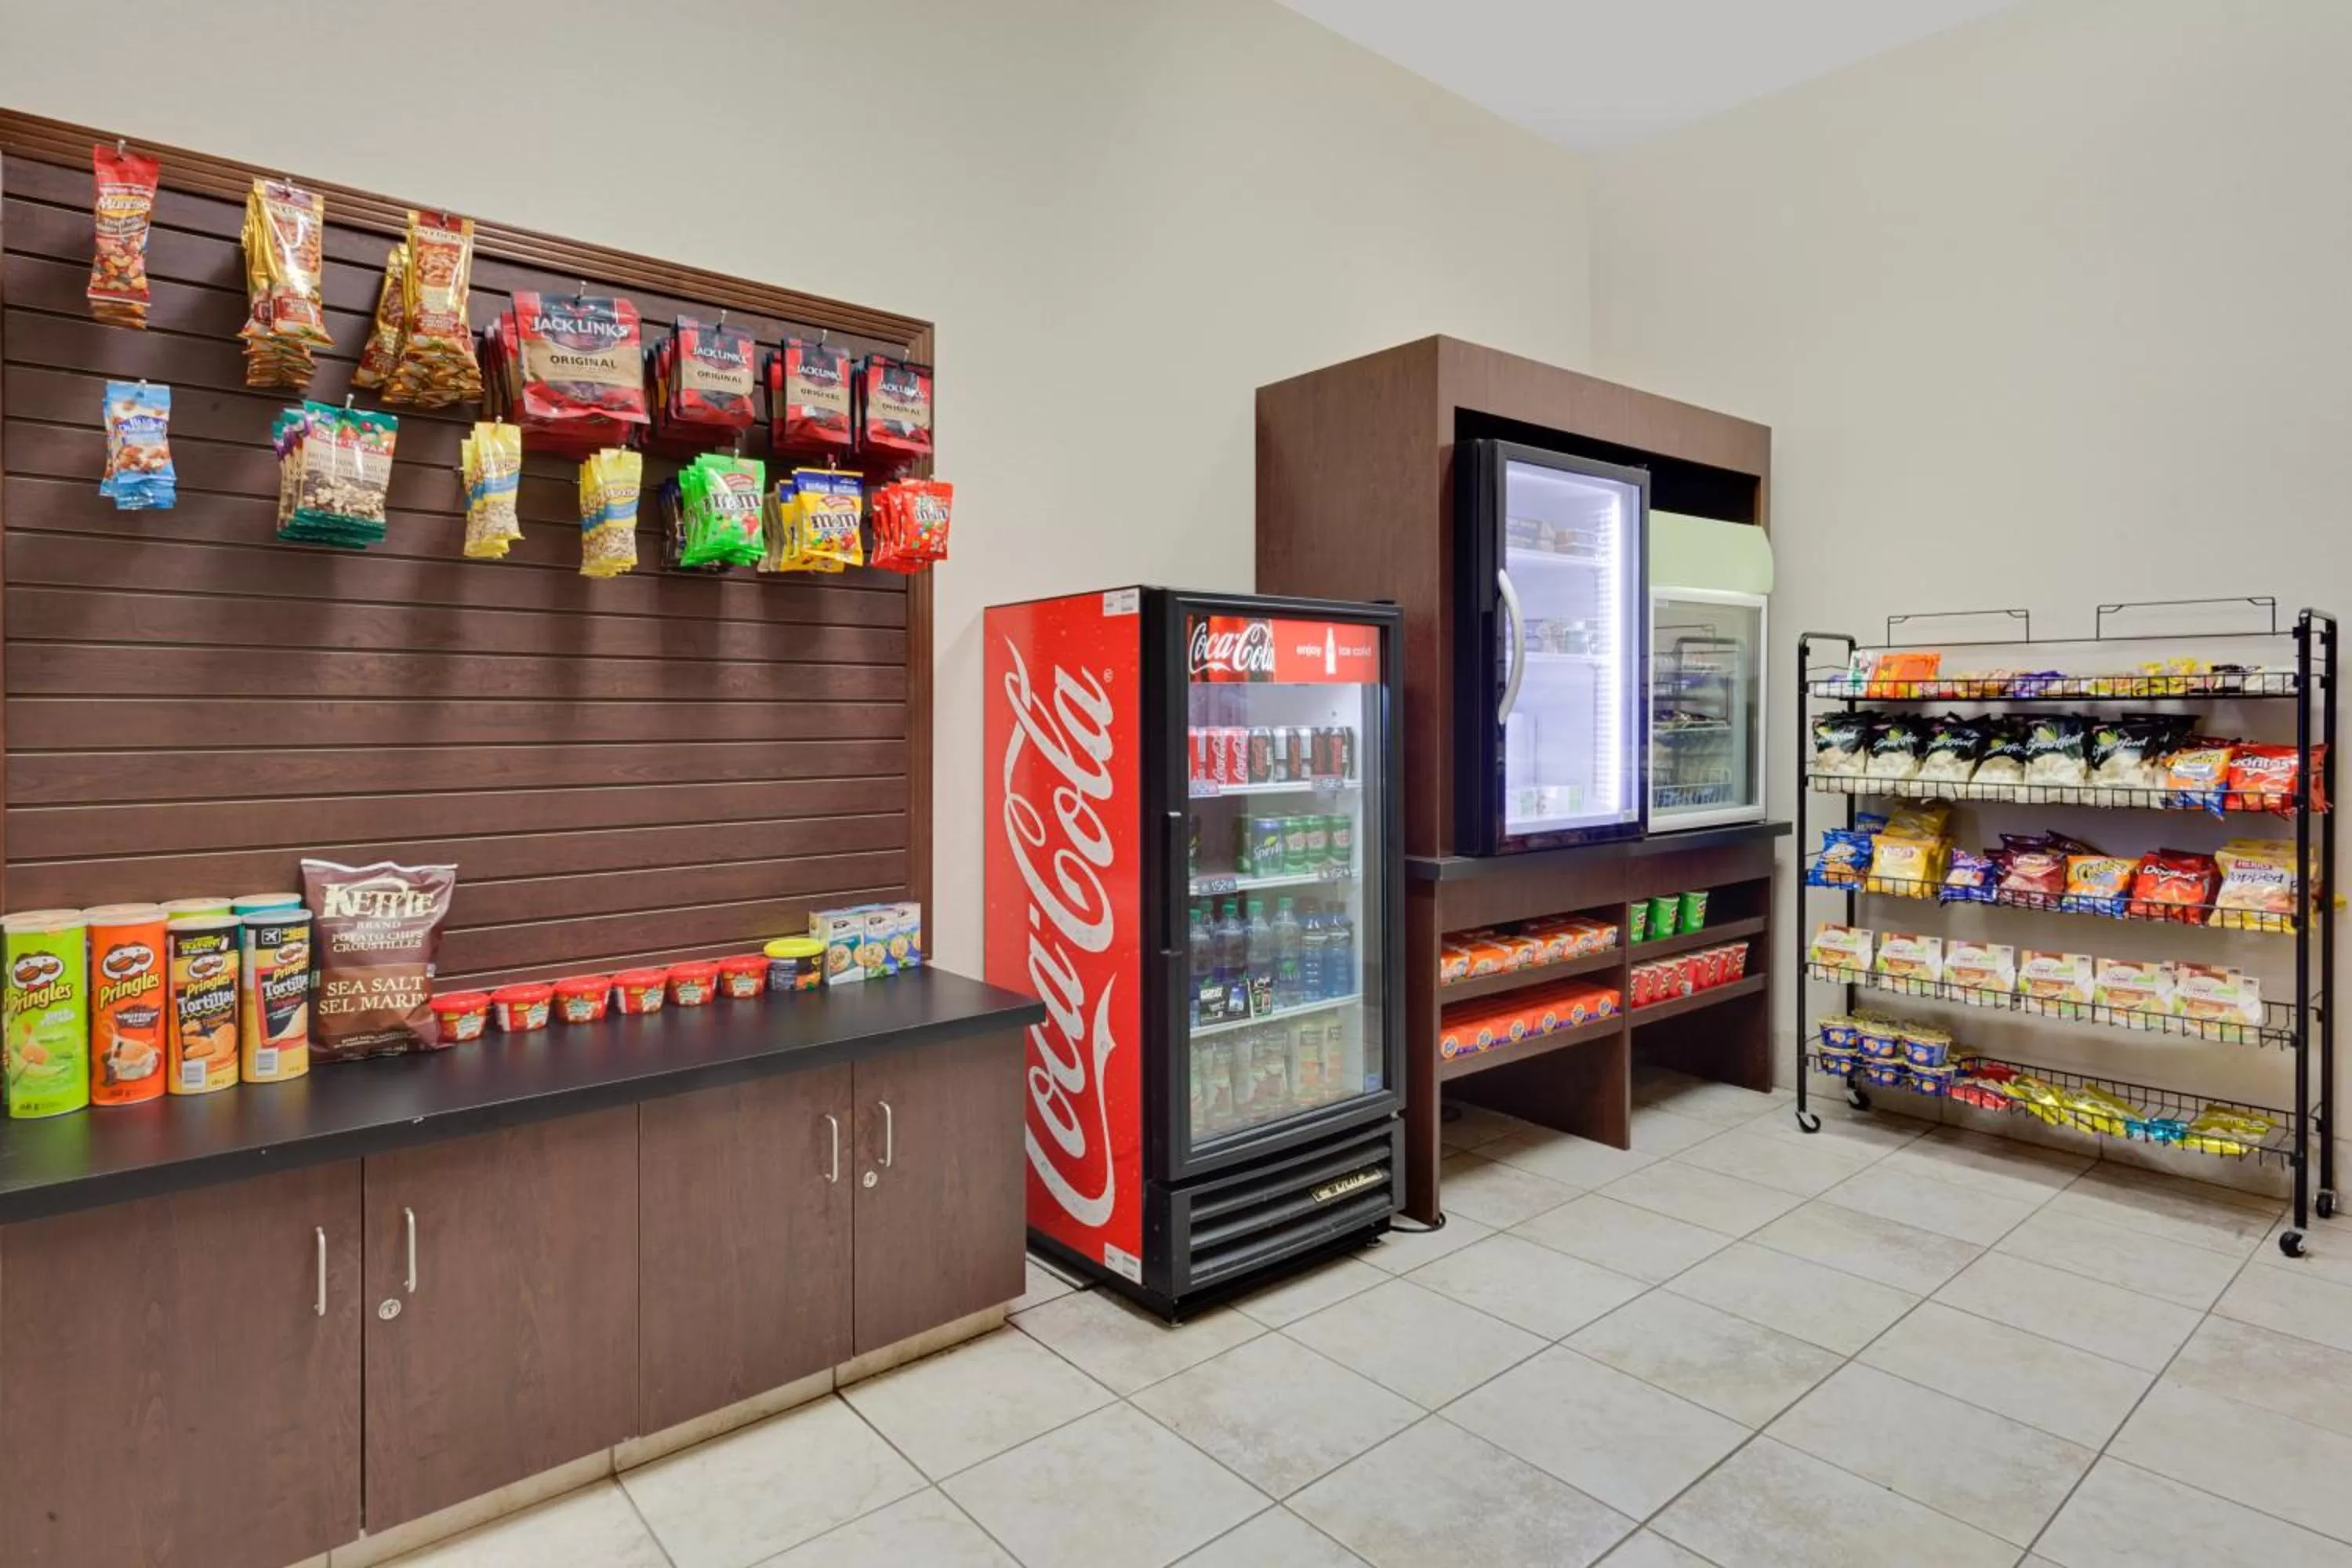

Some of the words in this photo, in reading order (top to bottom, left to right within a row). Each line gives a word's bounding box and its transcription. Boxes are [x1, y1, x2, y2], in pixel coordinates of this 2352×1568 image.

[531, 316, 577, 334] JACK
[550, 354, 618, 369] ORIGINAL
[697, 370, 742, 384] ORIGINAL
[1189, 622, 1275, 674] Coca-Cola
[1296, 644, 1322, 657] enjoy
[357, 920, 402, 930] BRAND
[1004, 636, 1116, 1228] Coca-Cola
[332, 931, 385, 943] POTATO
[387, 928, 424, 941] CHIPS
[332, 939, 423, 953] CROUSTILLES
[100, 971, 160, 1010] Pringles
[326, 980, 366, 996] SEA
[371, 976, 425, 993] SALT
[319, 998, 355, 1015] SEL
[360, 993, 428, 1011] MARIN
